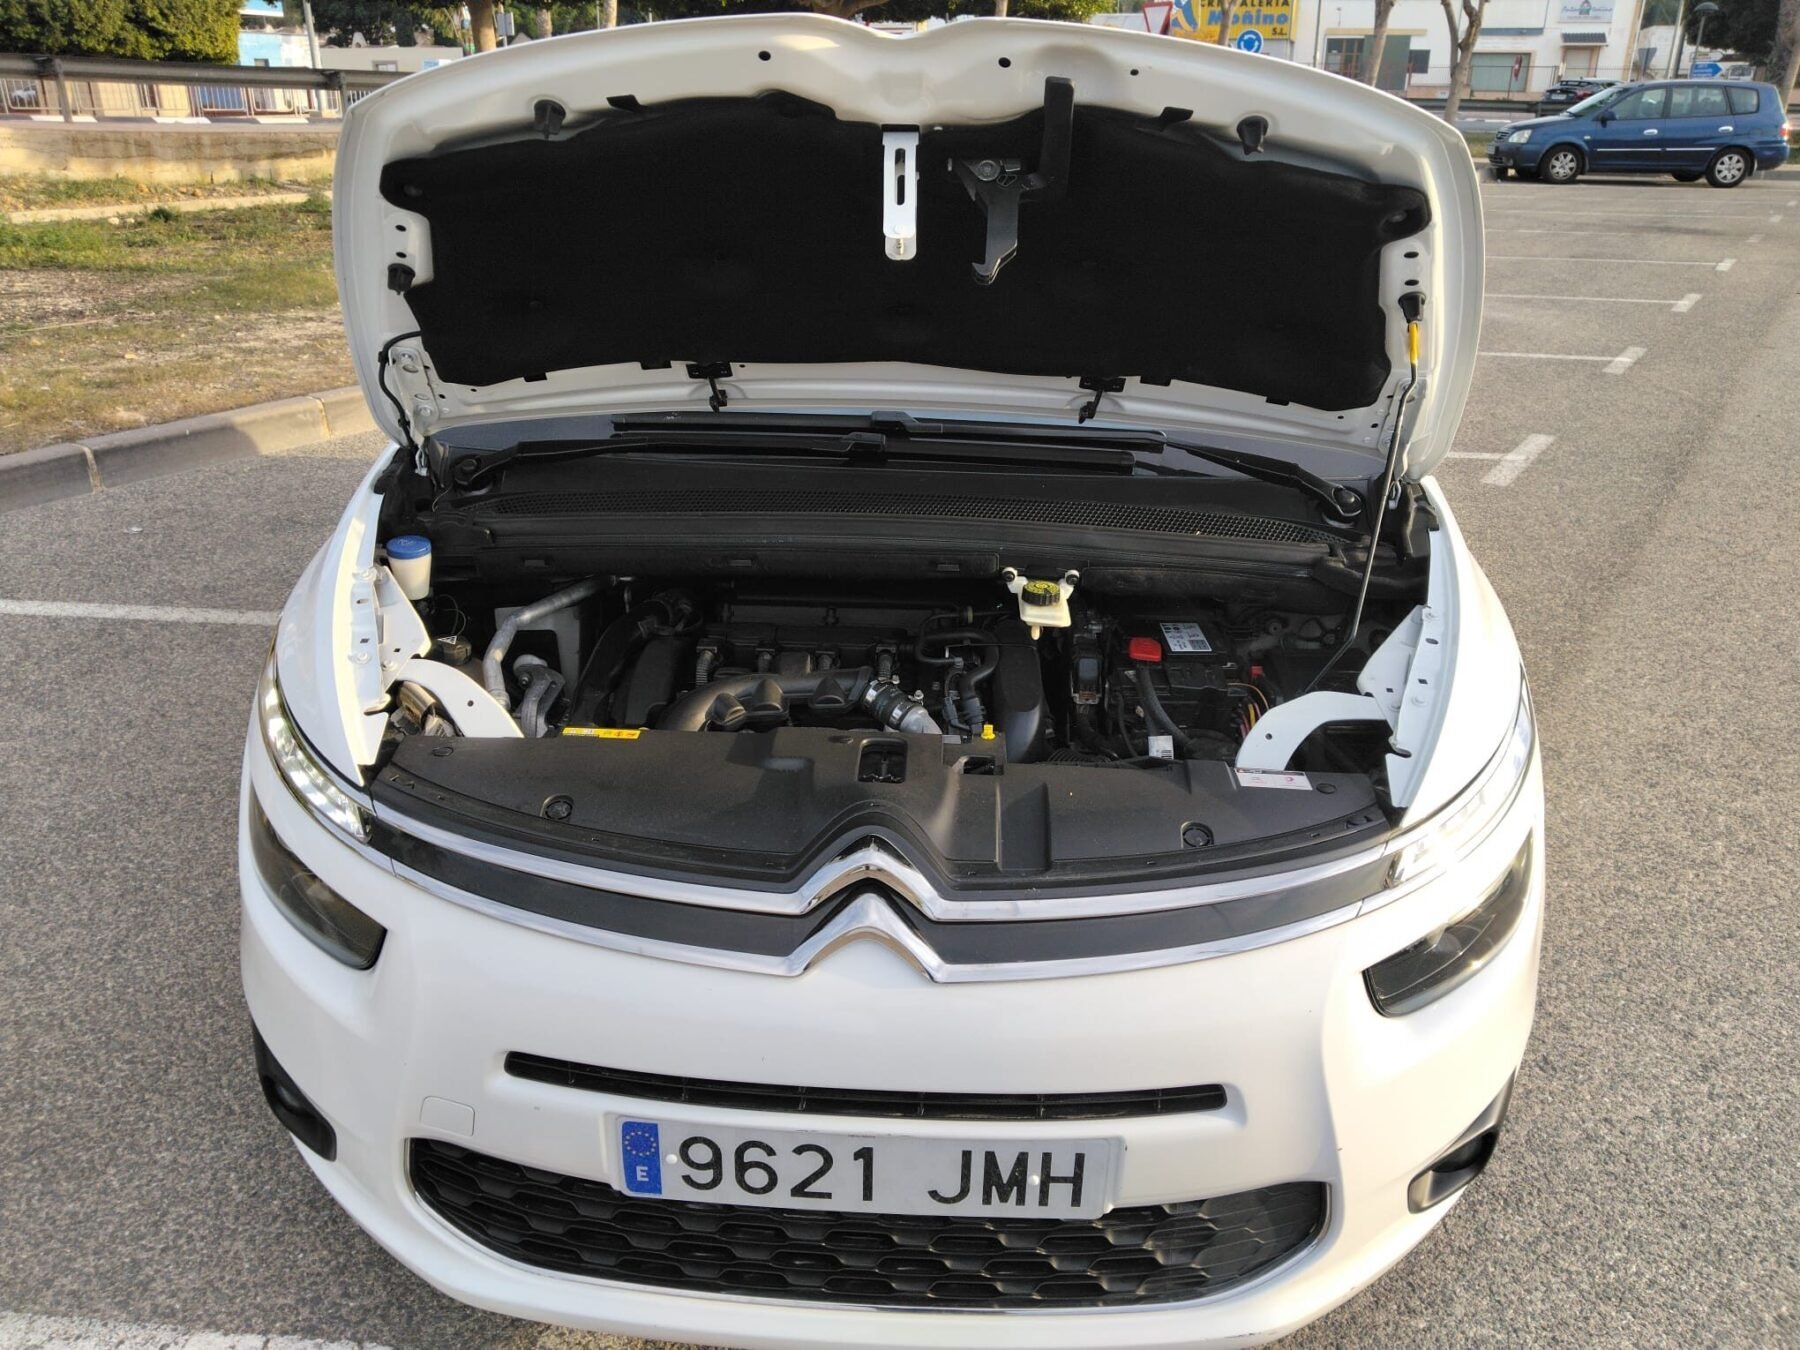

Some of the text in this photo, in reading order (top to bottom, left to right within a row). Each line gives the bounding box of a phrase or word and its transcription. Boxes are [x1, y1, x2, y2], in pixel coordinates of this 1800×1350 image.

[636, 1166, 649, 1181] E
[678, 1136, 1086, 1208] 9621 JMH
